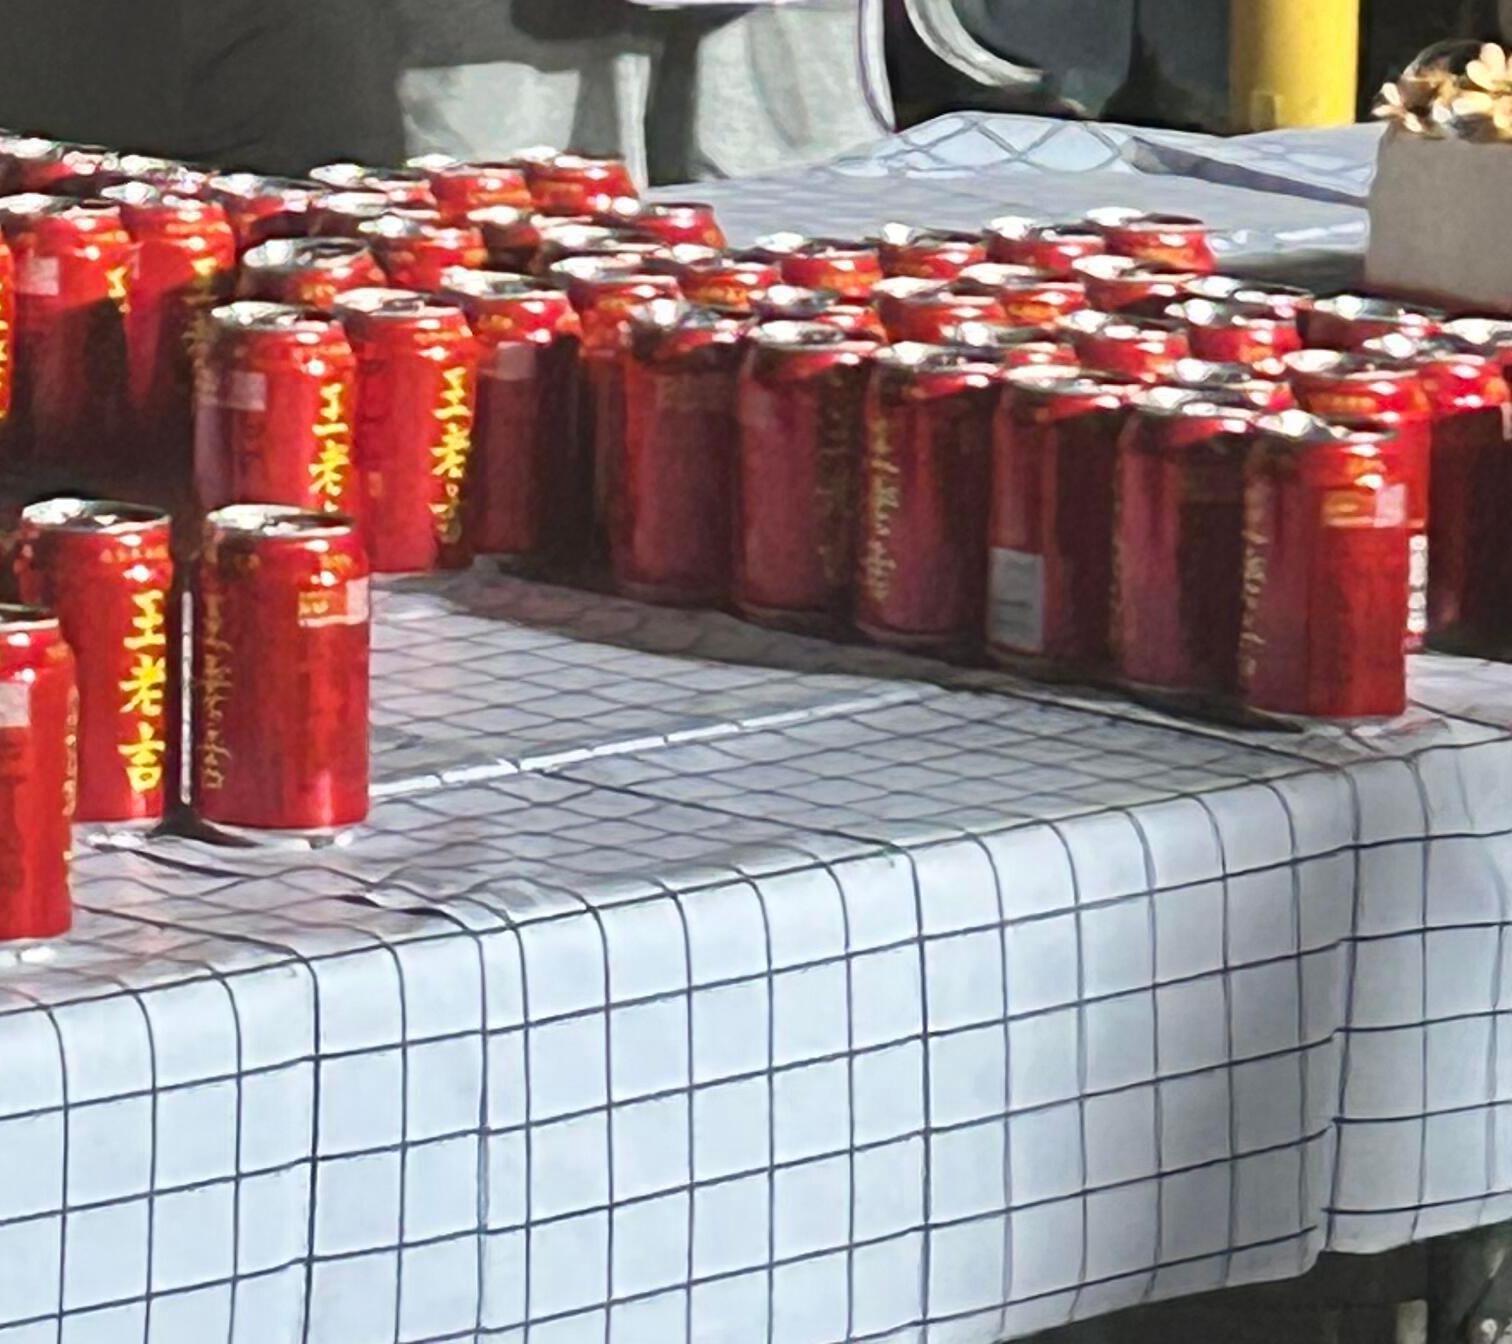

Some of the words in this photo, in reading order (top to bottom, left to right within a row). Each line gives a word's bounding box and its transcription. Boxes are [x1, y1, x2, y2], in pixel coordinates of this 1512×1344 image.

[308, 382, 351, 512] 王老
[117, 589, 166, 793] 王老吉
